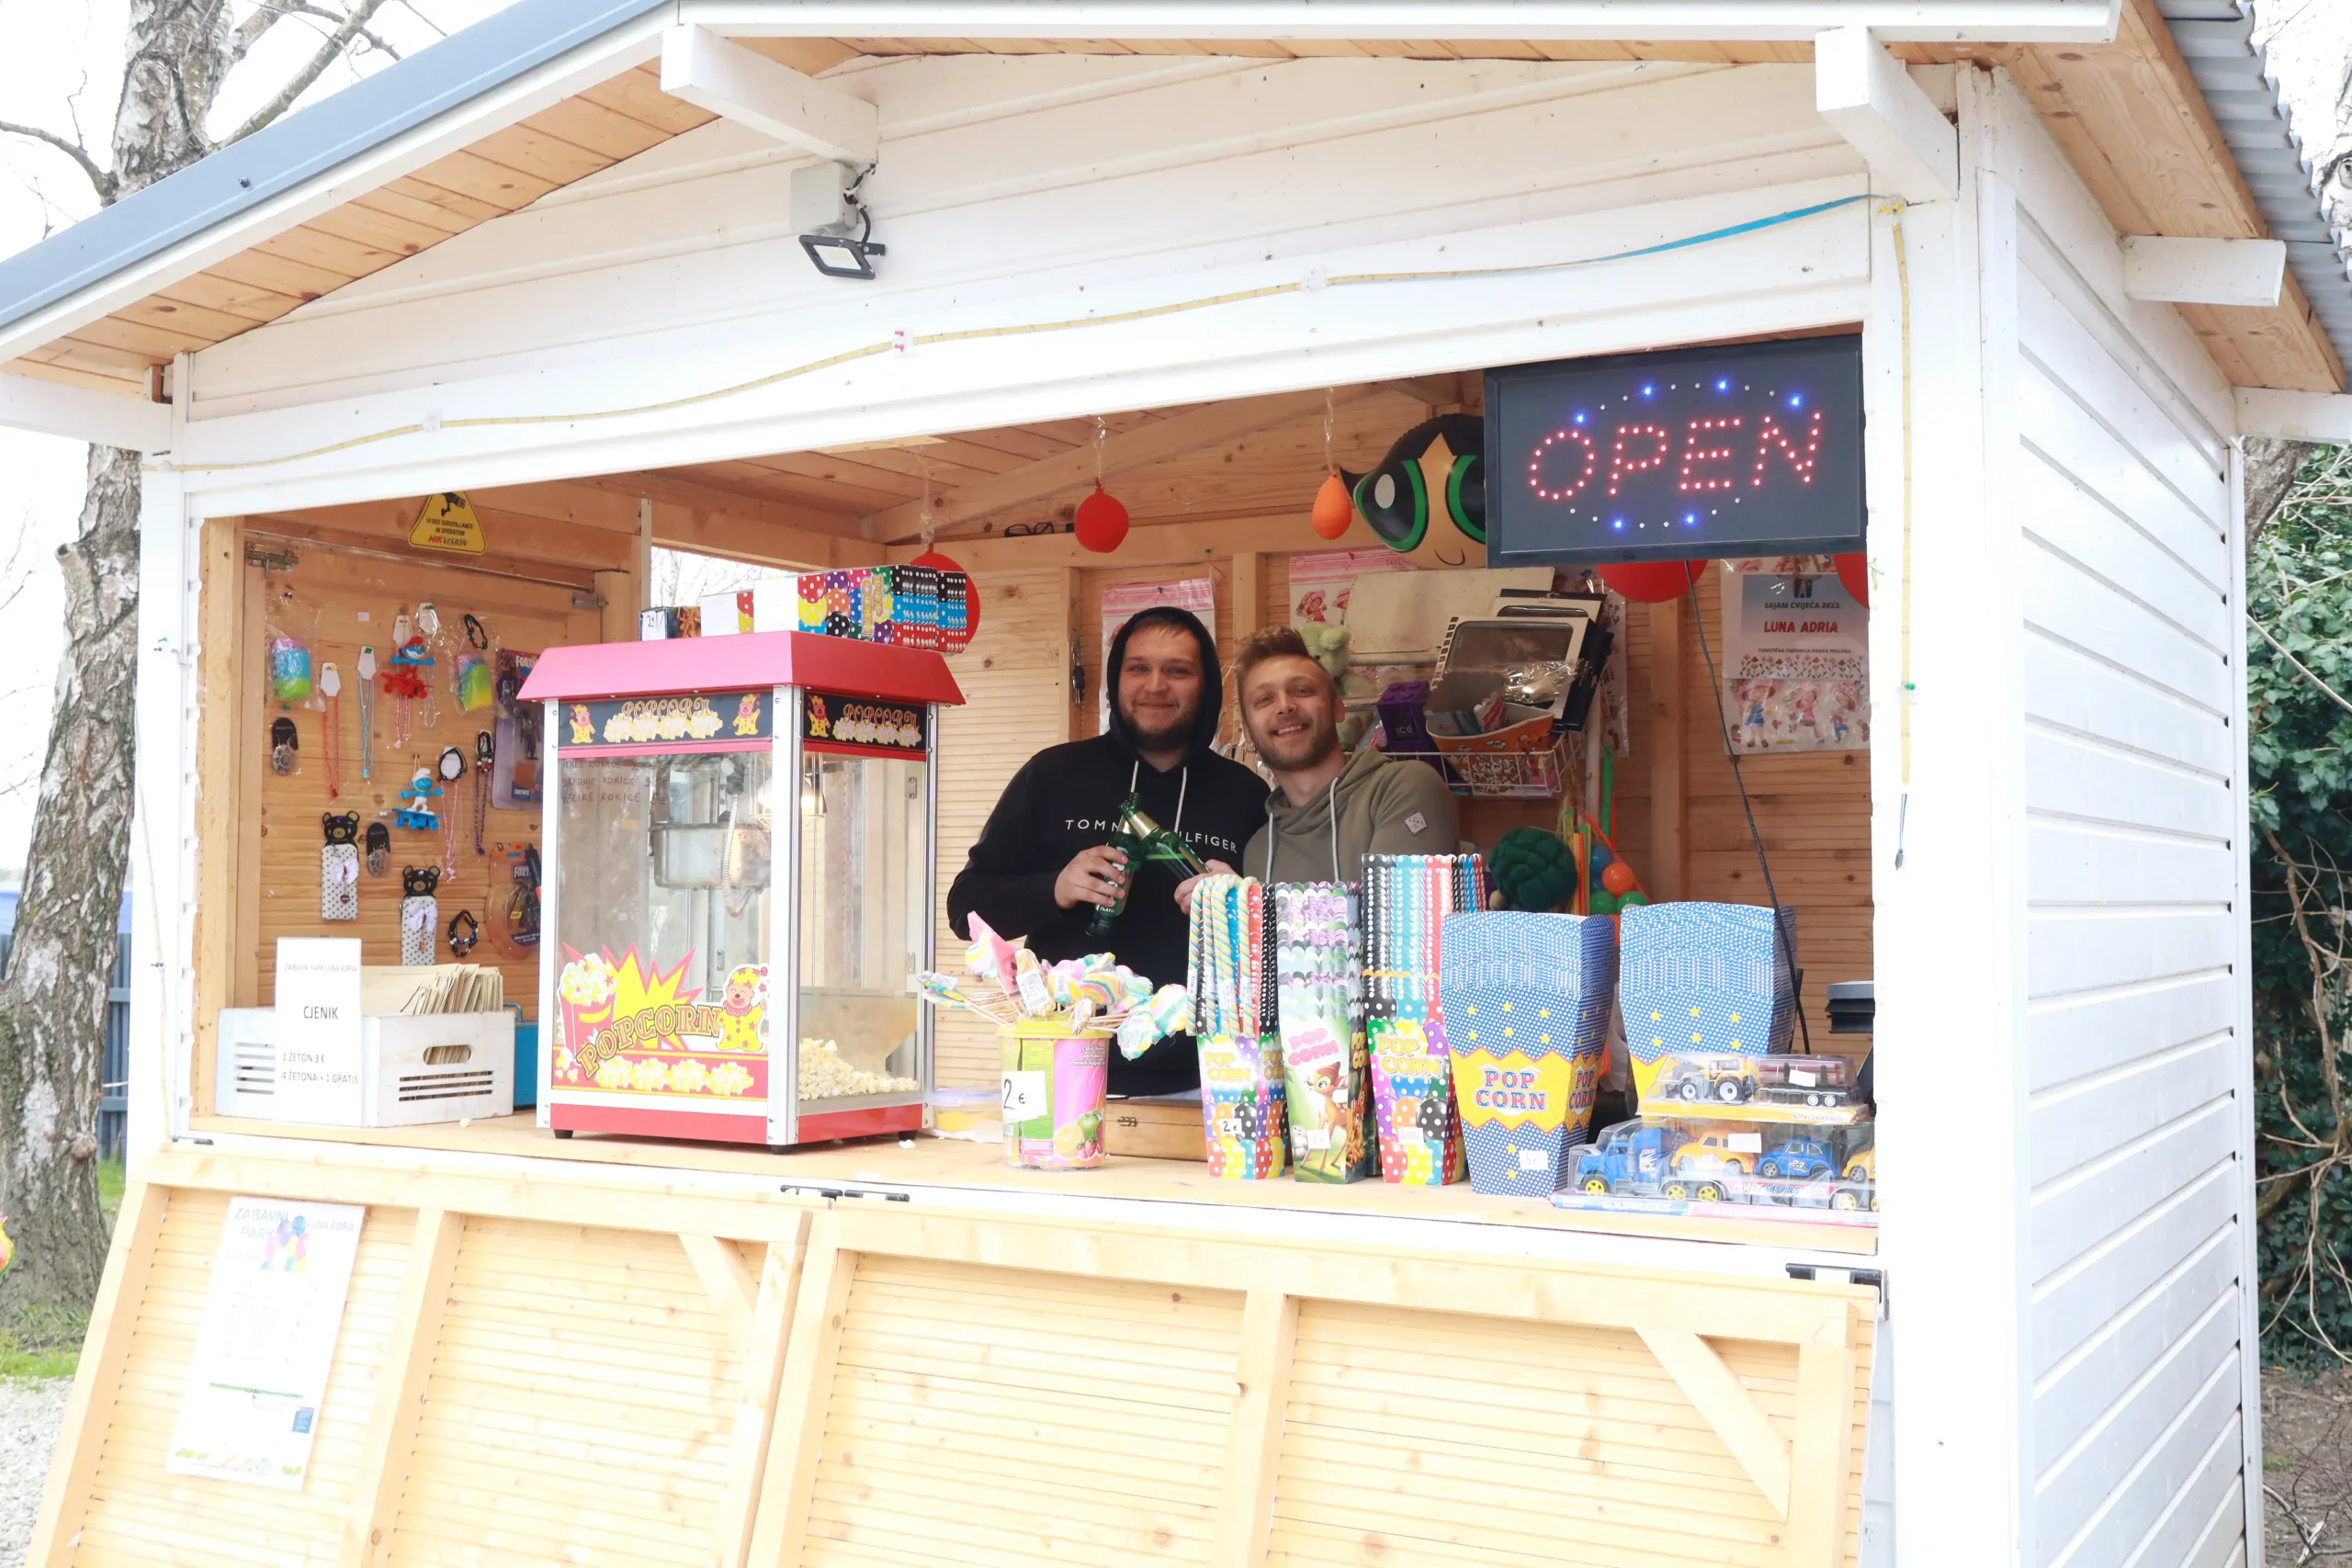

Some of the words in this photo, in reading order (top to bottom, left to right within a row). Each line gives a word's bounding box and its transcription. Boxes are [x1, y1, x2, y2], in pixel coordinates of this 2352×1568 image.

[1529, 412, 1821, 500] OPEN
[441, 520, 473, 529] SURVEILLANCE
[428, 536, 468, 547] HIKVISION
[873, 576, 883, 616] POP
[862, 580, 873, 637] CORN
[1764, 622, 1795, 633] LUNA
[1801, 622, 1838, 633] ADRIA
[622, 697, 710, 720] POPCORN
[842, 704, 918, 731] POPCORN
[601, 792, 640, 803] KOKICE
[1066, 819, 1118, 832] TOMM
[1177, 830, 1238, 854] ILFIGER
[303, 1006, 338, 1020] CJENIK
[575, 1004, 724, 1080] POPCORN
[1288, 1028, 1328, 1050] POP
[1377, 1036, 1420, 1056] POP
[1204, 1052, 1236, 1066] POP
[1288, 1040, 1340, 1066] CORN
[1207, 1066, 1250, 1081] CORN
[1382, 1055, 1442, 1077] CORN
[333, 1075, 358, 1084] GRATIS
[1485, 1070, 1535, 1089] POP
[1576, 1070, 1595, 1089] POP
[1476, 1089, 1545, 1110] CORN
[1569, 1089, 1594, 1110] CORN
[234, 1208, 288, 1223] ZABAVNI
